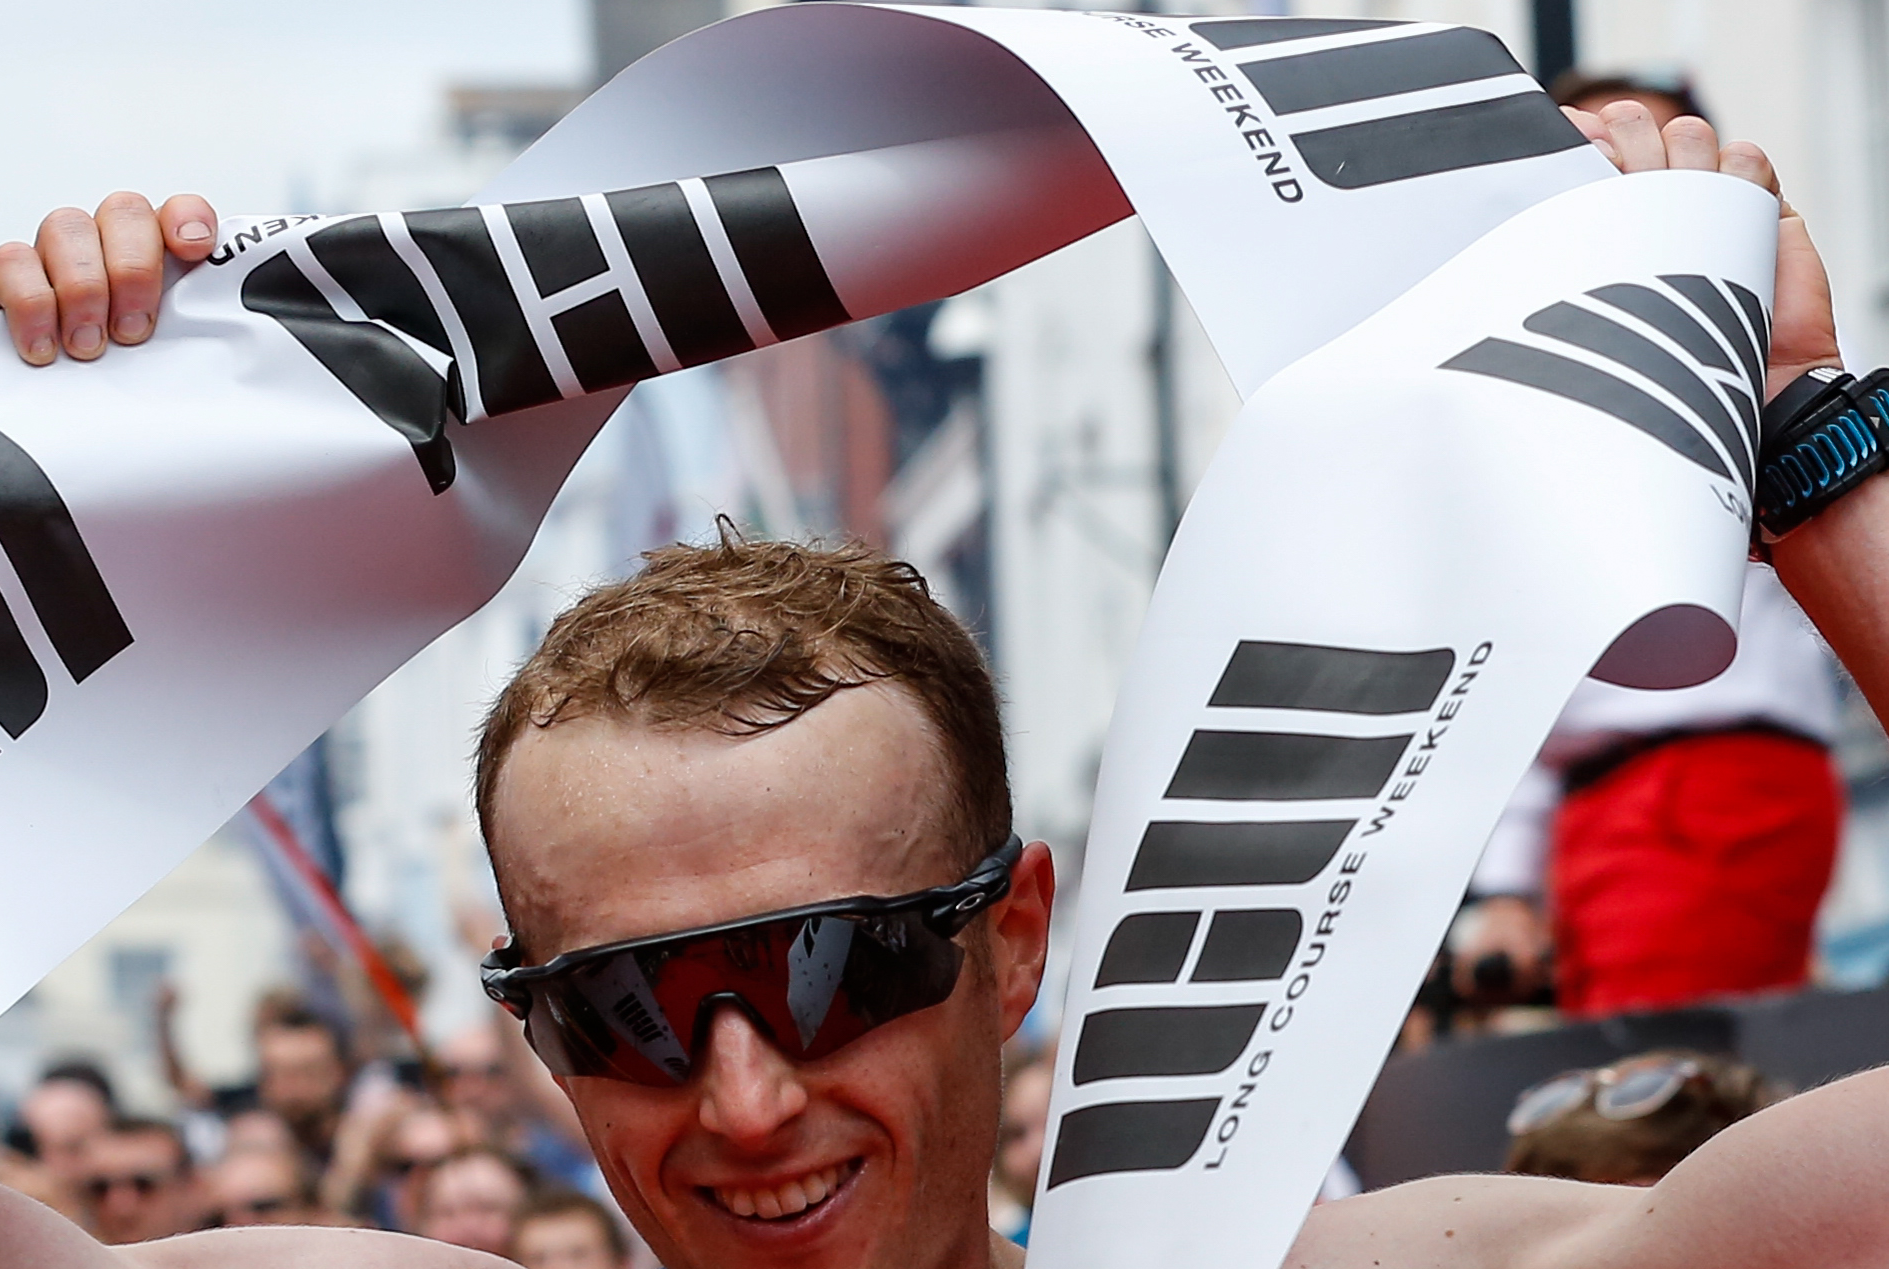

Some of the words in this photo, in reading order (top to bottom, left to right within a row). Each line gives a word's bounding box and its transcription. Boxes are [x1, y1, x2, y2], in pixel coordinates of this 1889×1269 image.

[1171, 42, 1304, 203] WEEKEND
[1205, 1050, 1271, 1171] LONG
[1271, 852, 1367, 1032] COURSE
[1363, 642, 1492, 839] WEEKEND
